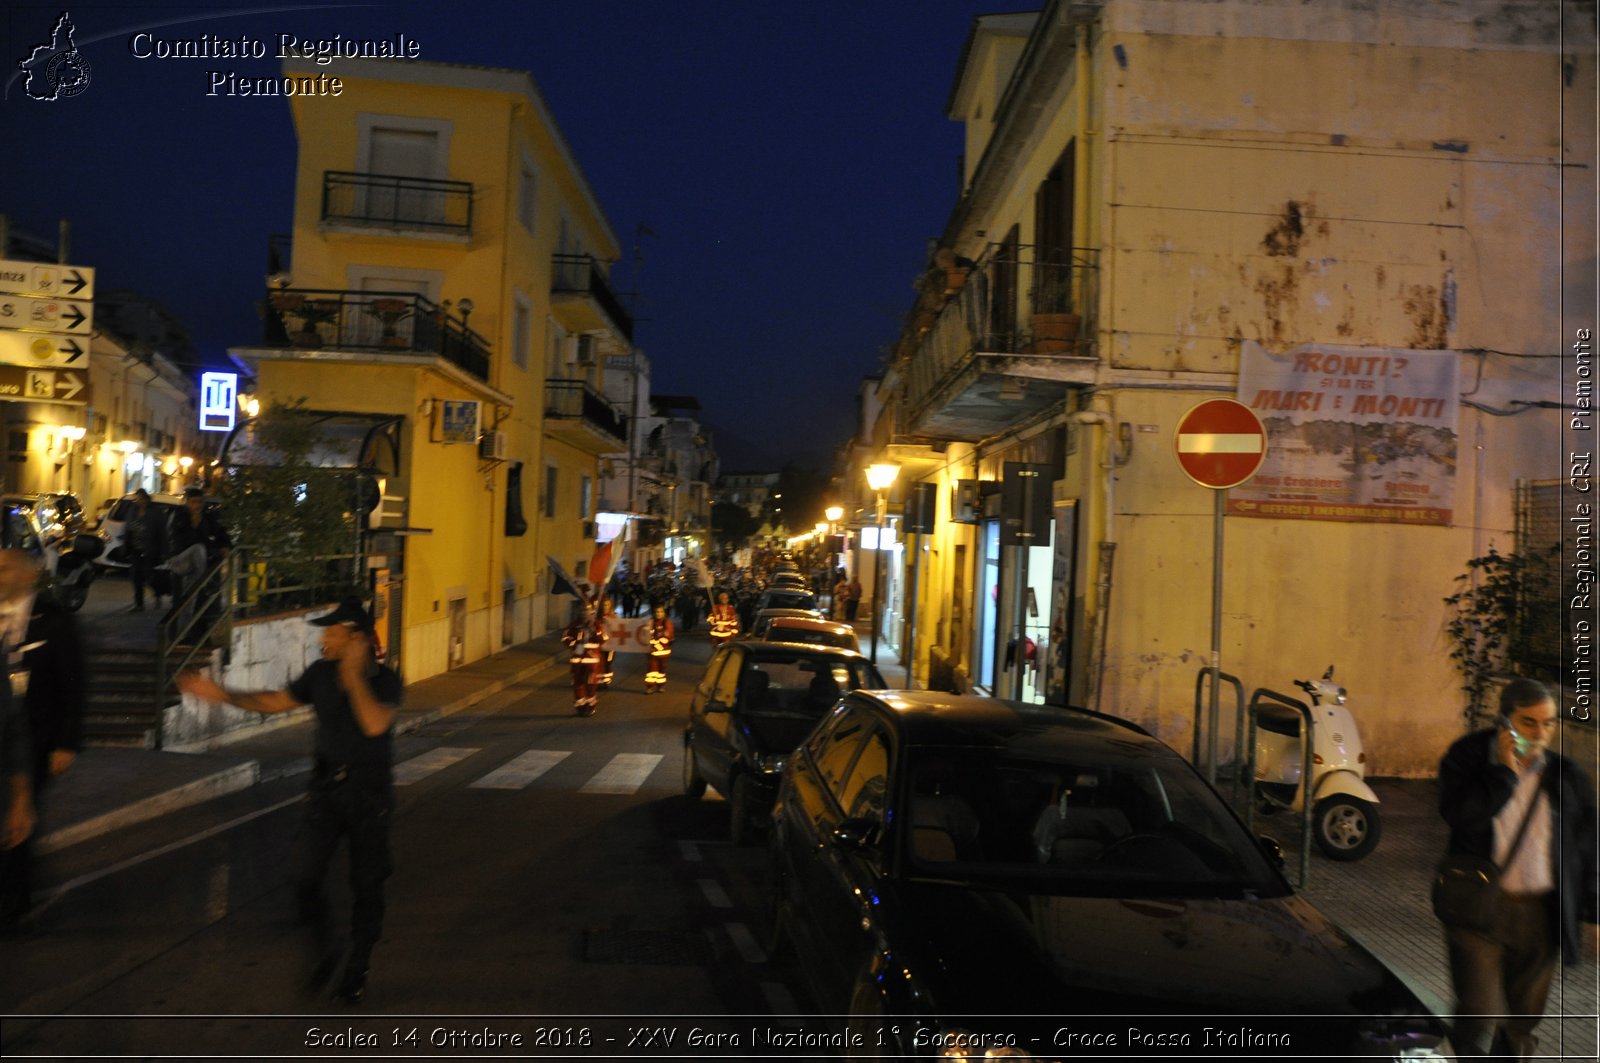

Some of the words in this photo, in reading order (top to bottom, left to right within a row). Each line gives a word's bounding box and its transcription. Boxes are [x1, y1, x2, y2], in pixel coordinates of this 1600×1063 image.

[1251, 389, 1325, 411] MARI
[1351, 394, 1446, 418] MONTI
[1283, 475, 1345, 489] Crociere
